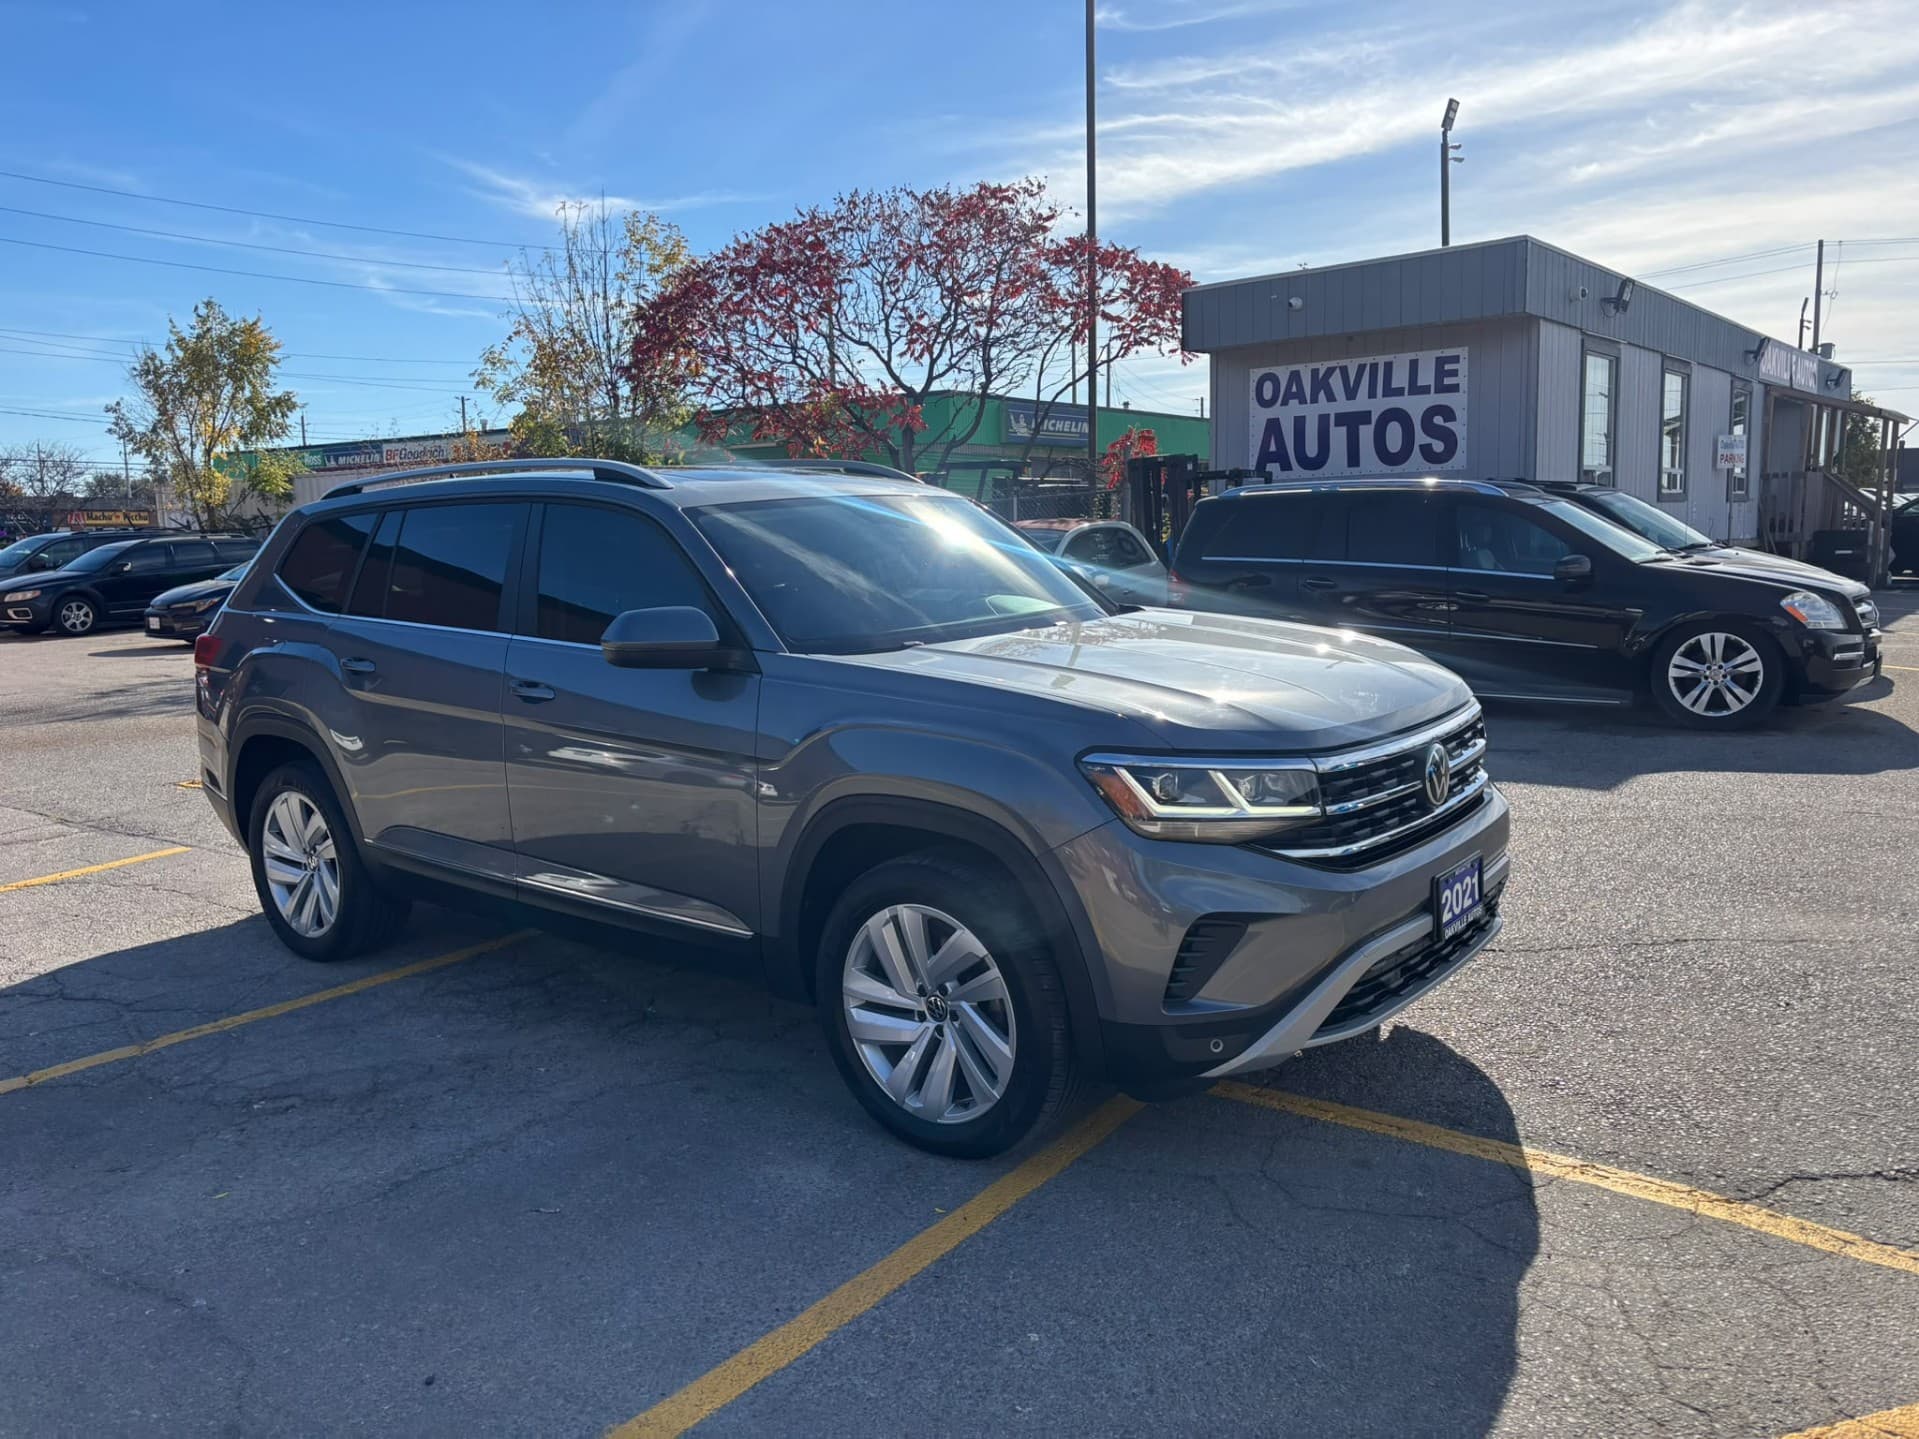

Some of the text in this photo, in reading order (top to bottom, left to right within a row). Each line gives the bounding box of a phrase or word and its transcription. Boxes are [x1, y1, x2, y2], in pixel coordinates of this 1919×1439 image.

[1255, 354, 1460, 409] OAKVILLE
[338, 453, 380, 465] MICHELIN
[1254, 403, 1458, 472] AUTOS
[1720, 453, 1745, 464] PARKING
[1441, 870, 1479, 924] 2021
